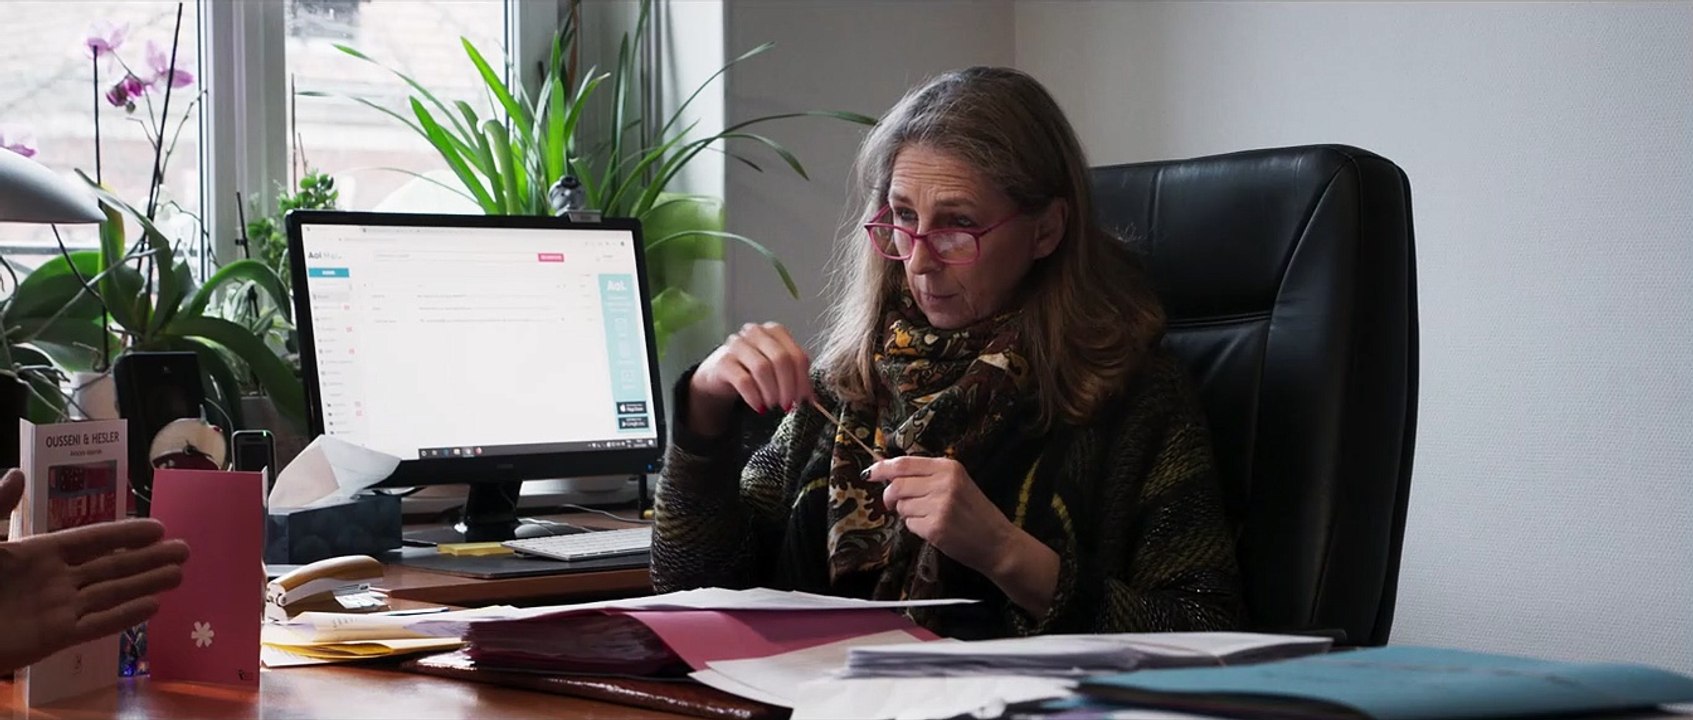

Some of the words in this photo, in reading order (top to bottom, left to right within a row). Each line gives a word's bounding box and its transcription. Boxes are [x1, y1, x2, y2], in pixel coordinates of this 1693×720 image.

[46, 434, 80, 448] OUSSENI
[83, 433, 90, 445] &
[92, 431, 119, 444] HESLER
